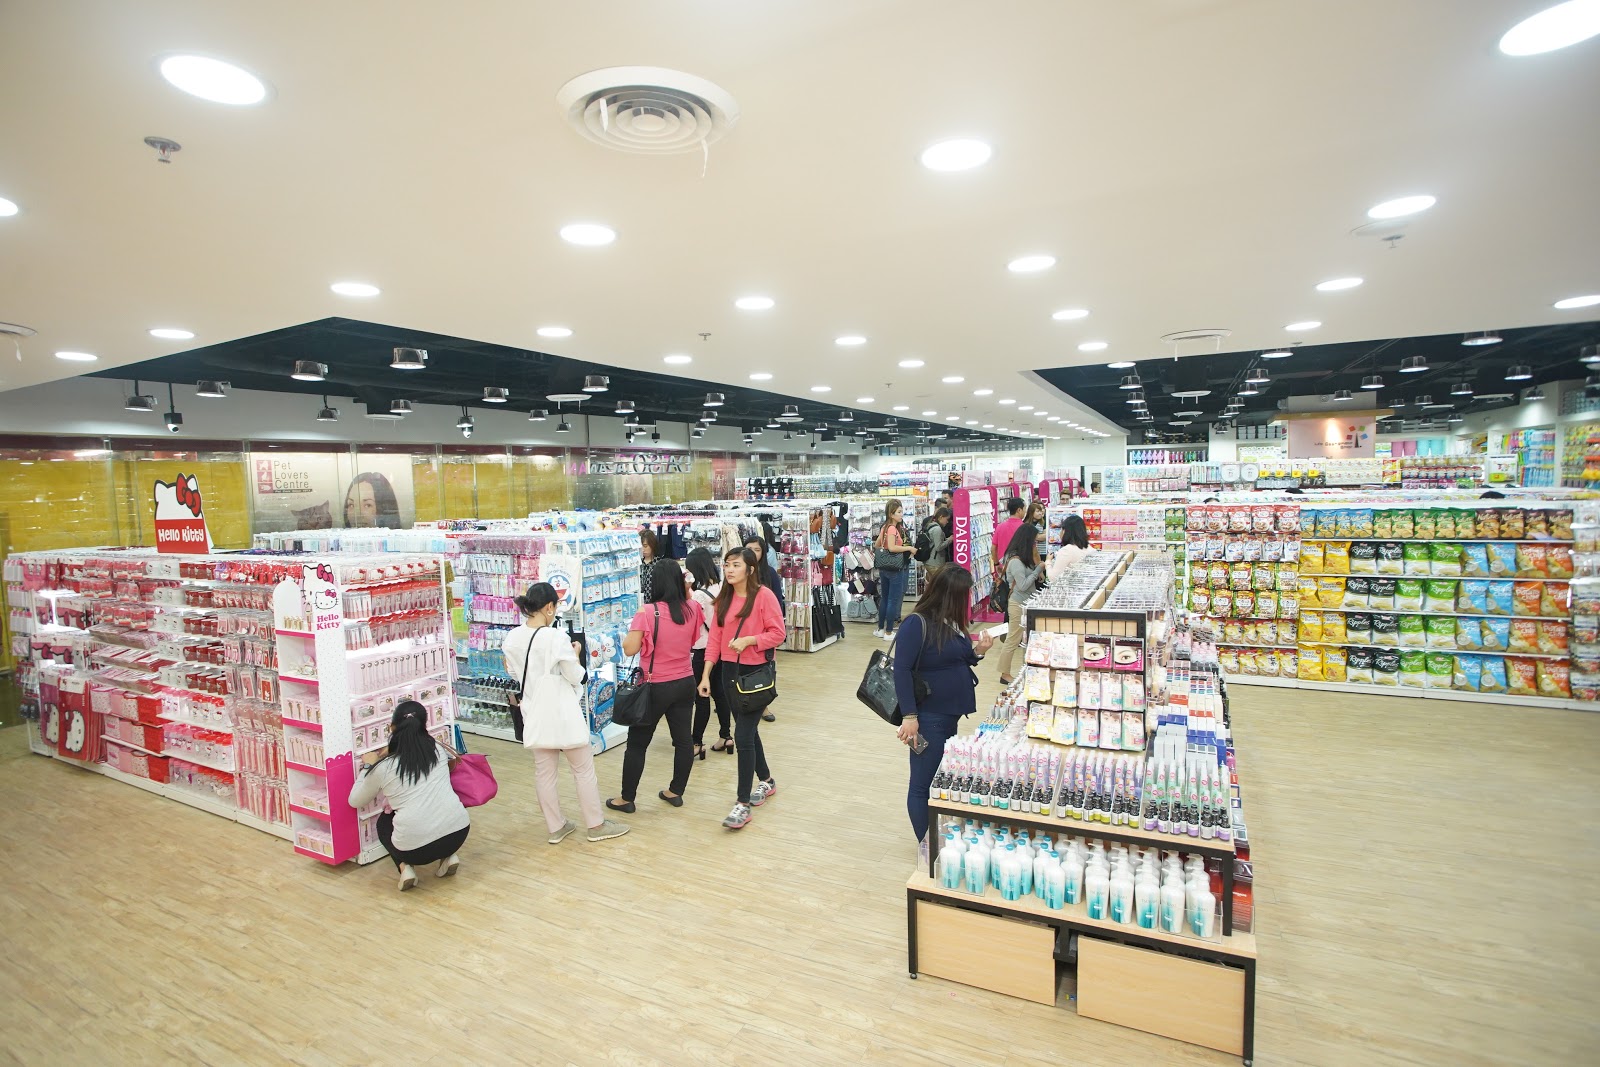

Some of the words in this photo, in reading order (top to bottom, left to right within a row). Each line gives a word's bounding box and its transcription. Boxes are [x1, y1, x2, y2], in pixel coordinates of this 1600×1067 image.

[274, 460, 291, 470] Pet
[274, 470, 309, 480] Lovers
[275, 480, 309, 489] Centre
[157, 528, 181, 543] Hello
[181, 525, 205, 543] Kitty
[955, 516, 968, 565] DAISO
[1348, 580, 1369, 591] Ripple
[1370, 583, 1395, 593] Ripples
[1398, 583, 1420, 592] Ripple
[317, 614, 339, 622] Hello
[1347, 618, 1370, 627] Ripples
[316, 622, 341, 630] Kitty
[1373, 620, 1398, 630] Ripples
